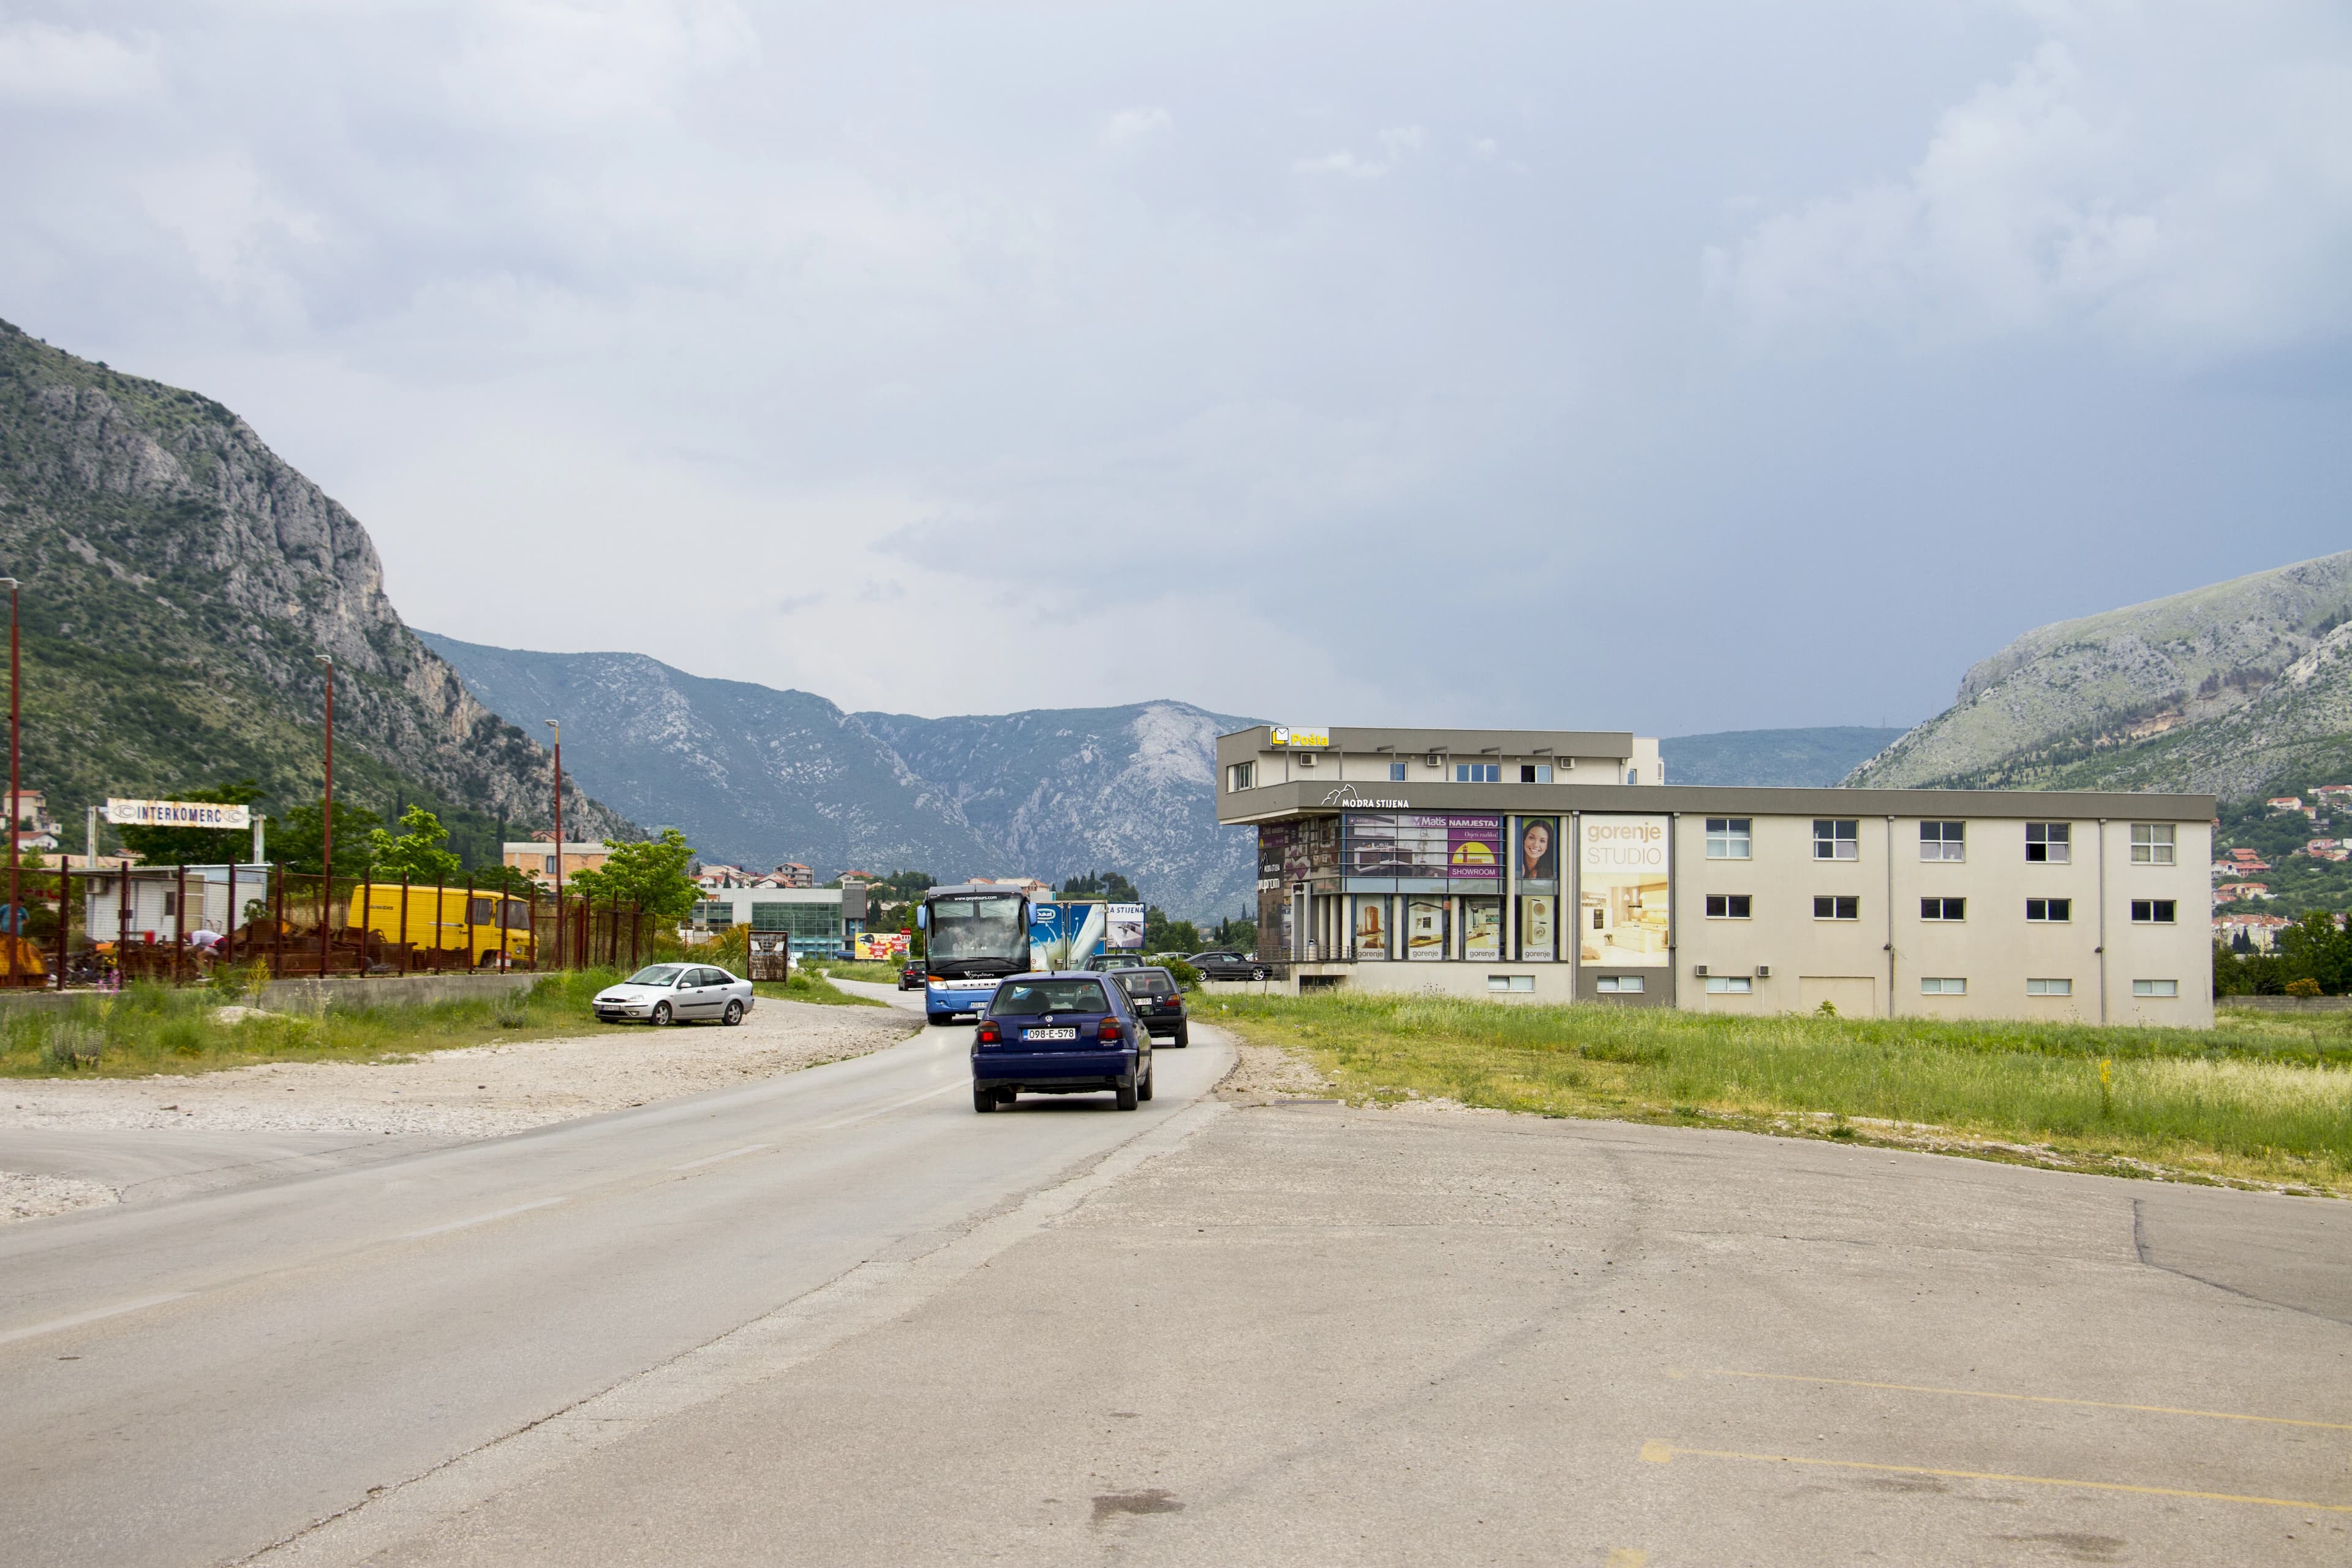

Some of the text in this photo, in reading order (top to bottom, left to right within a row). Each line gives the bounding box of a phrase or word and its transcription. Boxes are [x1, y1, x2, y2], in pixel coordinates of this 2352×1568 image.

[1291, 733, 1328, 745] Pošta
[137, 805, 221, 823] INTERKOMERC
[1422, 816, 1446, 826] Matis
[1588, 822, 1661, 843] gorenje
[1588, 847, 1661, 864] STUDIO
[1029, 1029, 1074, 1039] 098-E-578
